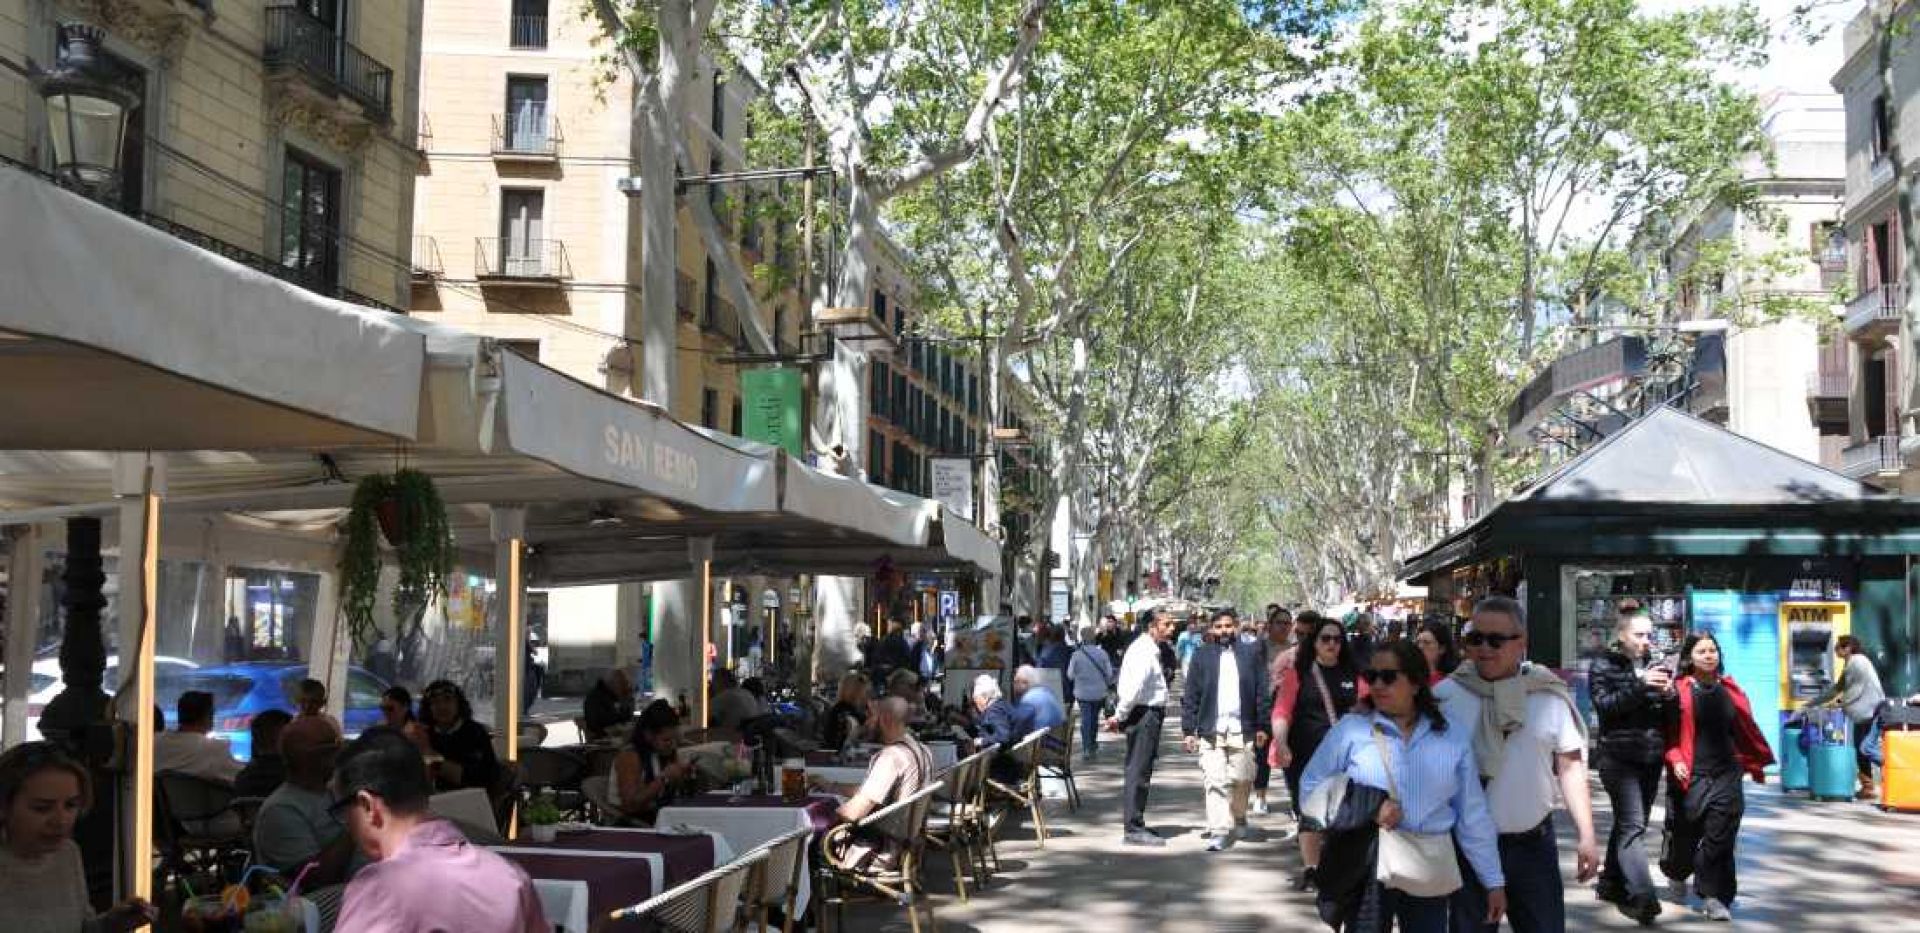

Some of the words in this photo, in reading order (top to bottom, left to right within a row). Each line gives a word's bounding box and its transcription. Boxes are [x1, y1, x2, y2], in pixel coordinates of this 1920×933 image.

[604, 424, 648, 474] SAN
[654, 443, 699, 489] REMO
[1791, 579, 1822, 591] ATM
[1788, 608, 1829, 621] ATM
